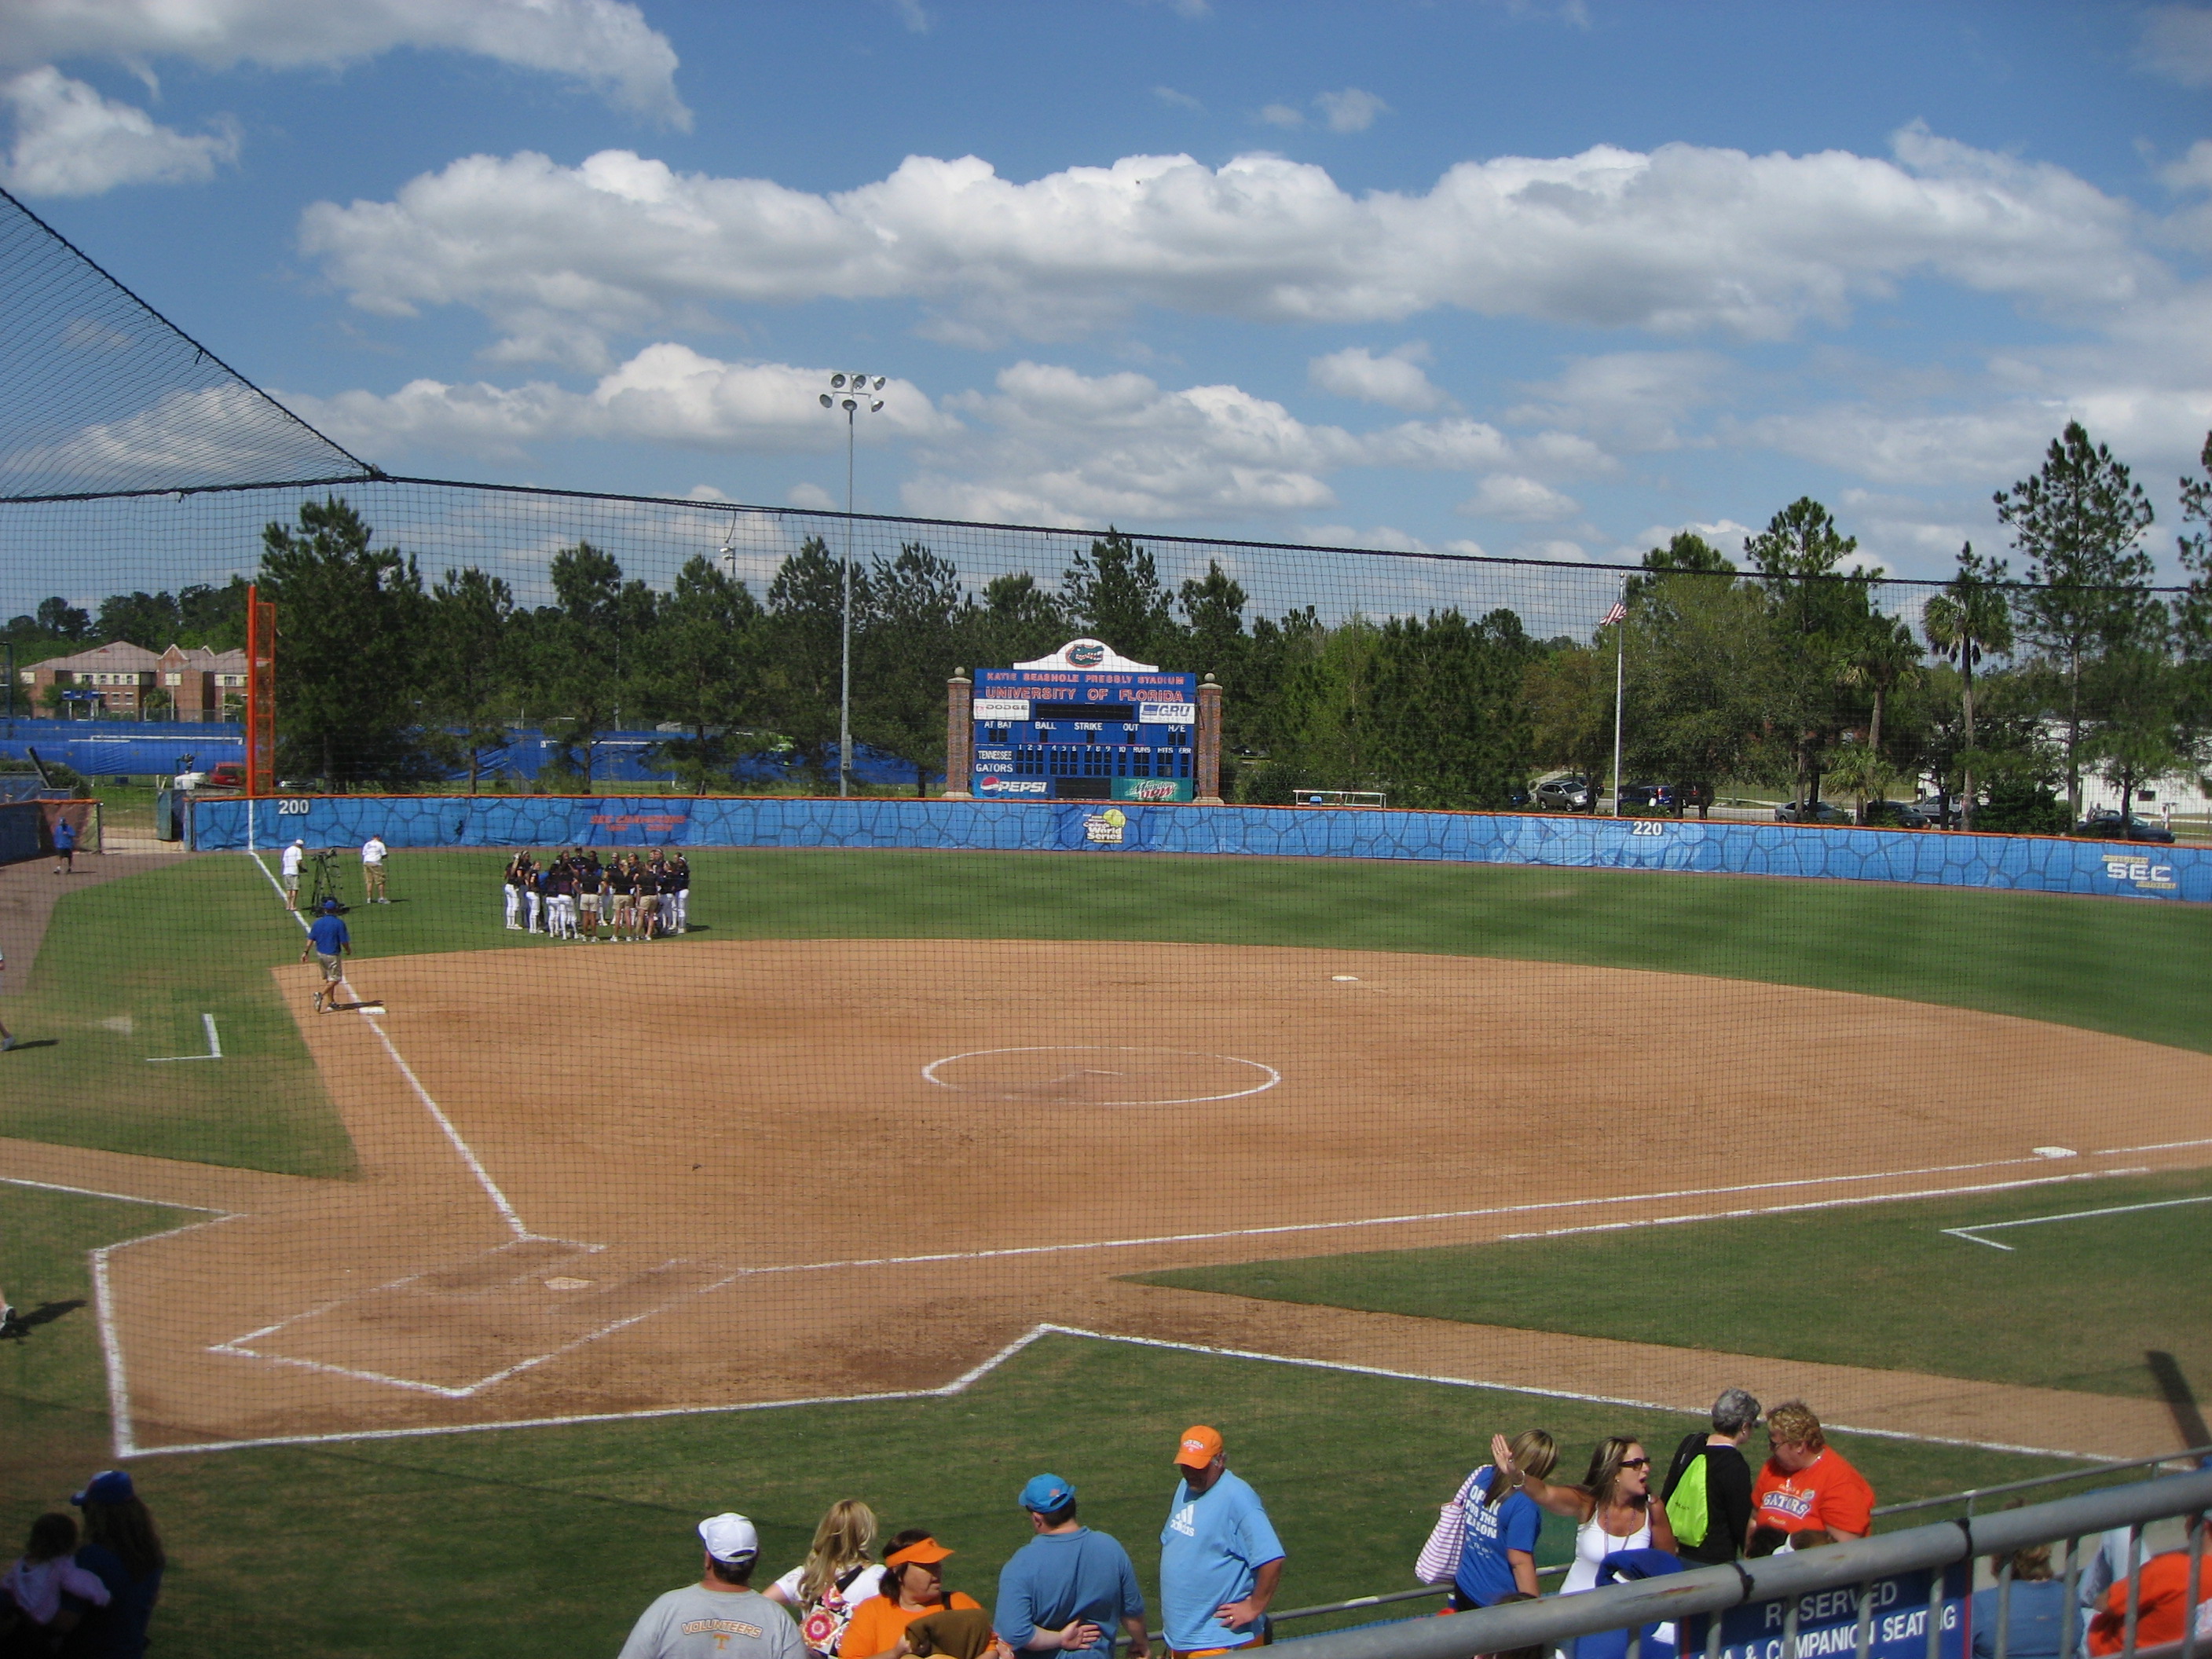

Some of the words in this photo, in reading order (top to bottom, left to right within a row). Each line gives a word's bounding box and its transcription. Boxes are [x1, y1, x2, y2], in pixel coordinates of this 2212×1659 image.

[987, 672, 1017, 681] KATIE
[986, 686, 1076, 700] UNIVERSITY
[1087, 688, 1108, 701] OF
[1119, 689, 1183, 701] FLORIDA
[1159, 705, 1191, 716] GRU
[978, 750, 1013, 760] TENNESSEE
[976, 764, 1013, 773] GATORS
[998, 781, 1048, 793] PEPSI
[278, 799, 309, 815] 200
[1632, 821, 1662, 836] 220
[2107, 862, 2171, 882] SEC
[1469, 1485, 1501, 1516] OPN
[1763, 1493, 1808, 1514] GATORS
[1465, 1499, 1479, 1518] FOR
[1479, 1511, 1498, 1527] THE
[1170, 1519, 1195, 1537] adidas
[1465, 1512, 1498, 1539] EASON
[1766, 1580, 1897, 1628] RSERVED
[682, 1618, 764, 1639] VOLUNTEERS
[1882, 1605, 1956, 1643] SEATG
[713, 1633, 732, 1650] T
